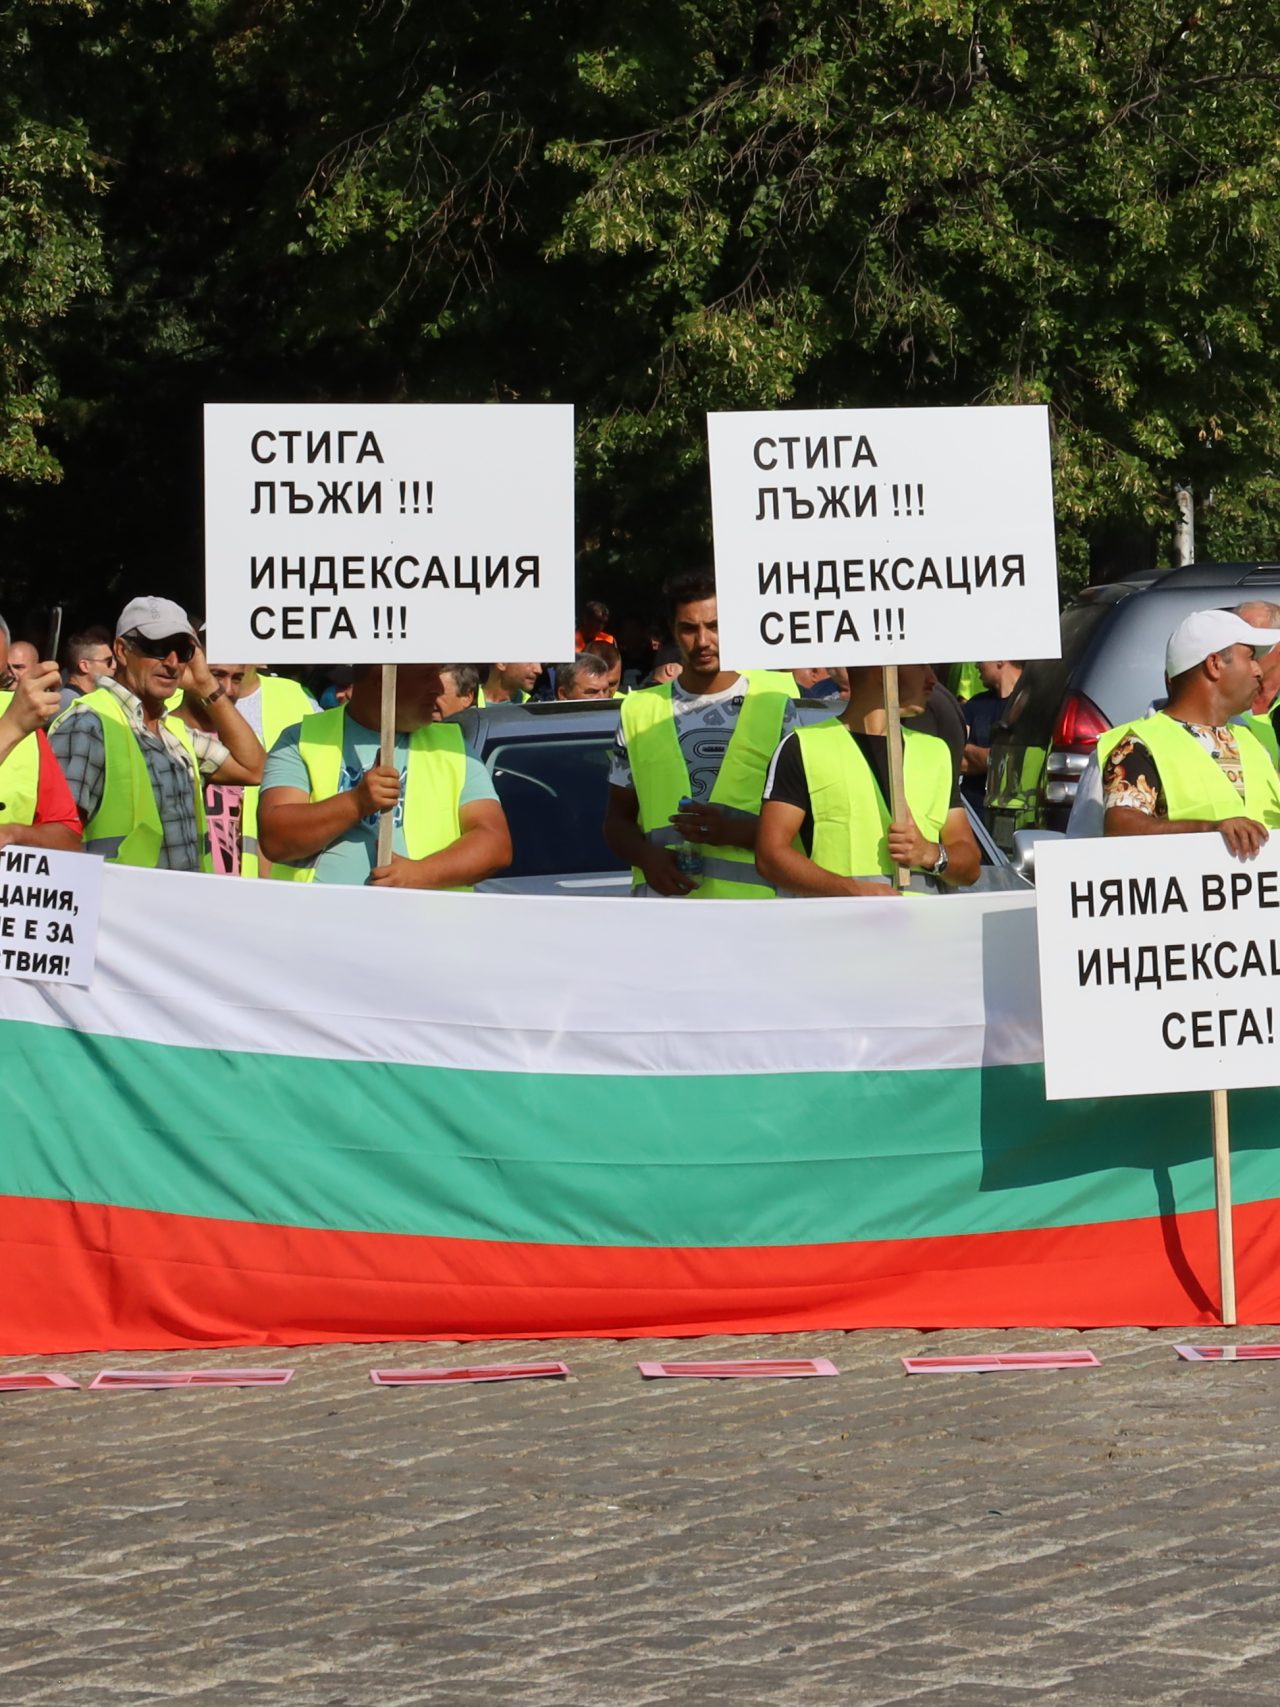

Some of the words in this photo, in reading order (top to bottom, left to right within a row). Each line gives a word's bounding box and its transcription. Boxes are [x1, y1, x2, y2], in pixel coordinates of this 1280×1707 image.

[250, 429, 385, 465] СТИГА
[753, 435, 878, 471] СТИГА
[250, 480, 382, 515] ЛЪЖИ
[399, 480, 433, 514] !!!
[755, 484, 878, 521] ЛЪЖИ
[892, 483, 925, 517] !!!
[250, 555, 540, 597] ИНДЕКСАЦИЯ
[757, 554, 1025, 601] ИНДЕКСАЦИЯ
[250, 605, 358, 641] СЕГА
[372, 605, 407, 639] !!!
[759, 609, 860, 646] СЕГА
[873, 607, 905, 641] !!!
[1070, 876, 1189, 919] НЯМА
[24, 919, 38, 940] Е
[46, 921, 74, 944] ЗА
[1161, 1007, 1274, 1050] СЕГА!
